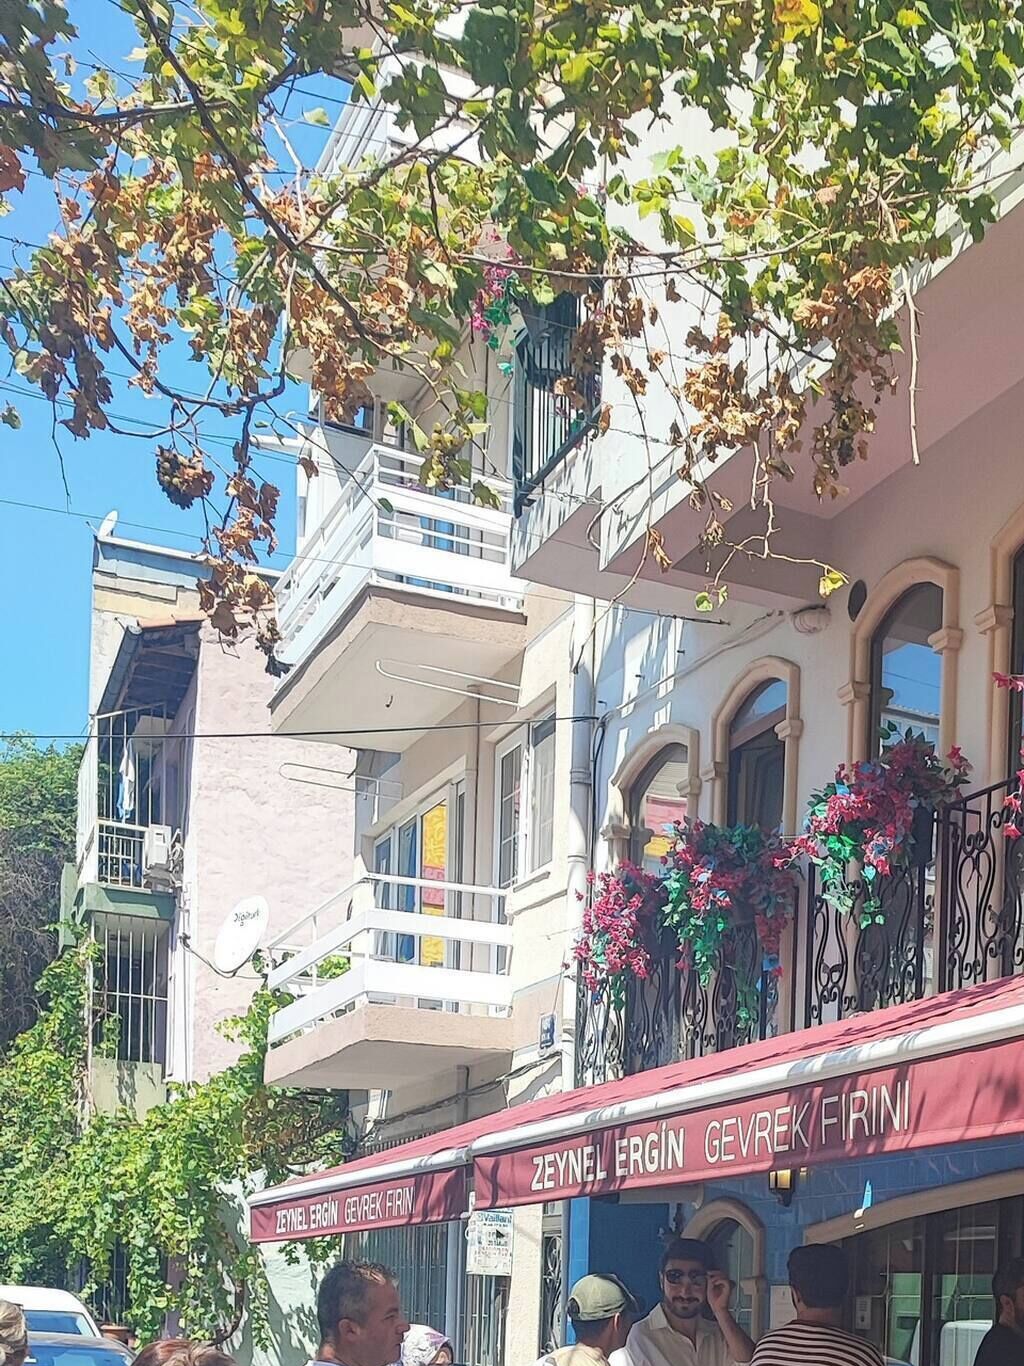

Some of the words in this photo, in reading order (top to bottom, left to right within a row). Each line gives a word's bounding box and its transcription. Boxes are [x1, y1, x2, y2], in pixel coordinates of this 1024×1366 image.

[531, 1144, 607, 1191] ZEYNEL
[615, 1121, 685, 1177] ERGİN
[704, 1102, 810, 1164] GEVREK
[821, 1079, 910, 1145] FIRINI
[275, 1208, 308, 1234] ZEYNEL
[309, 1196, 339, 1228] ERGİN
[344, 1191, 384, 1224] GEVREK
